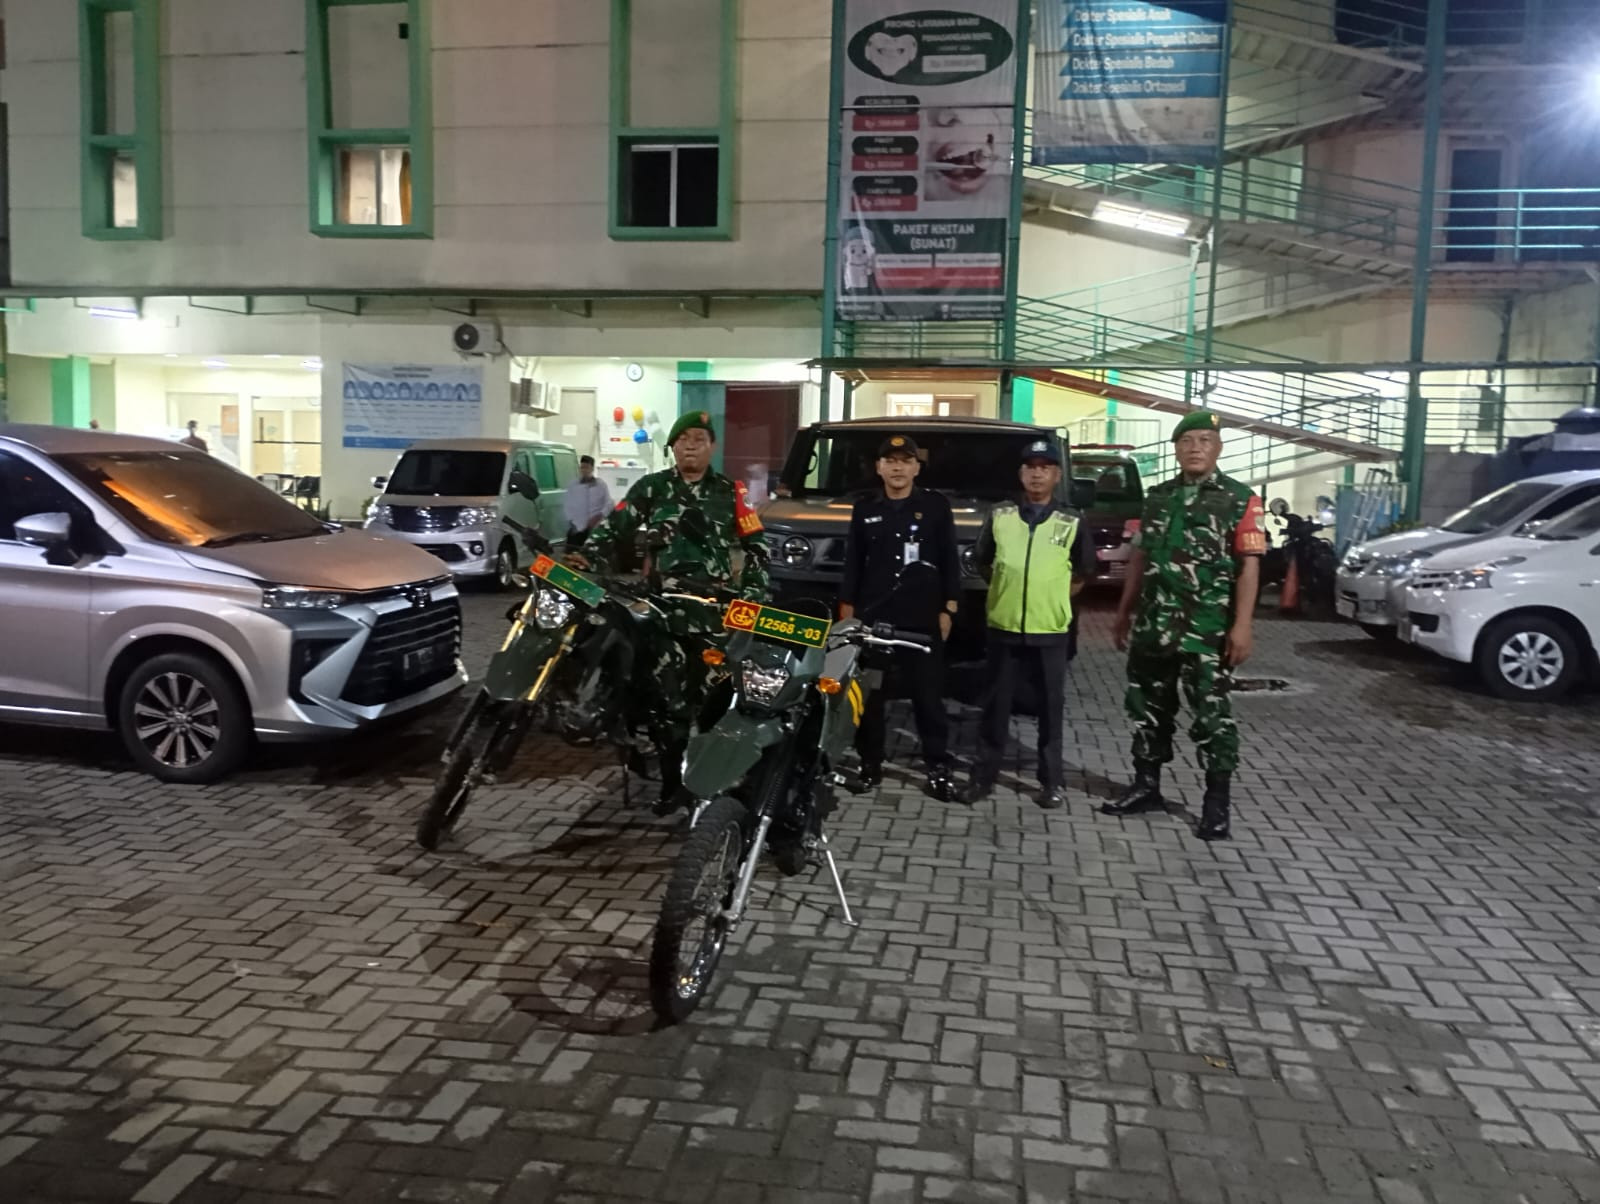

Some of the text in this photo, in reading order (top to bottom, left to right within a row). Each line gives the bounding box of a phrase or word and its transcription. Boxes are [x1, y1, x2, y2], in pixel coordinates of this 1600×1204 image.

[1073, 33, 1104, 46] Dokter
[893, 223, 975, 235] PAKET KHITAN
[911, 238, 957, 250] (SUNAT)
